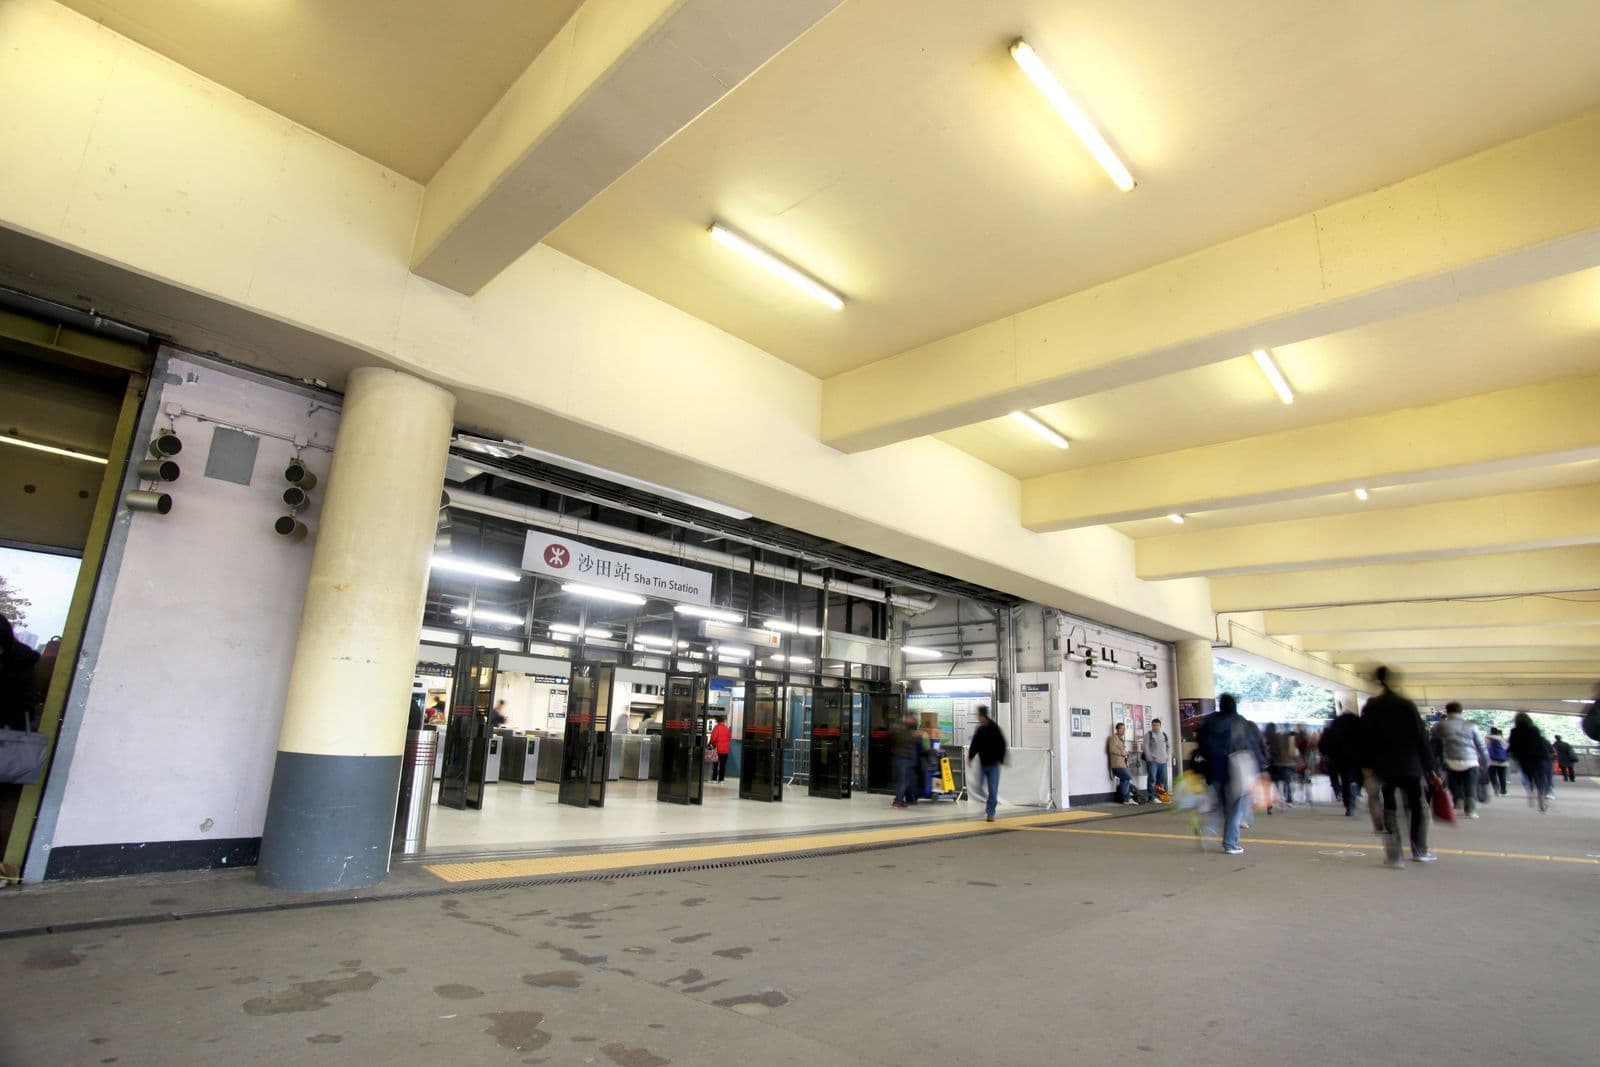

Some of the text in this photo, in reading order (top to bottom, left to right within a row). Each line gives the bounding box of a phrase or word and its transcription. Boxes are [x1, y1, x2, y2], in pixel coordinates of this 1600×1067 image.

[578, 553, 631, 582] 沙田站
[634, 573, 699, 595] Sha Tin Station
